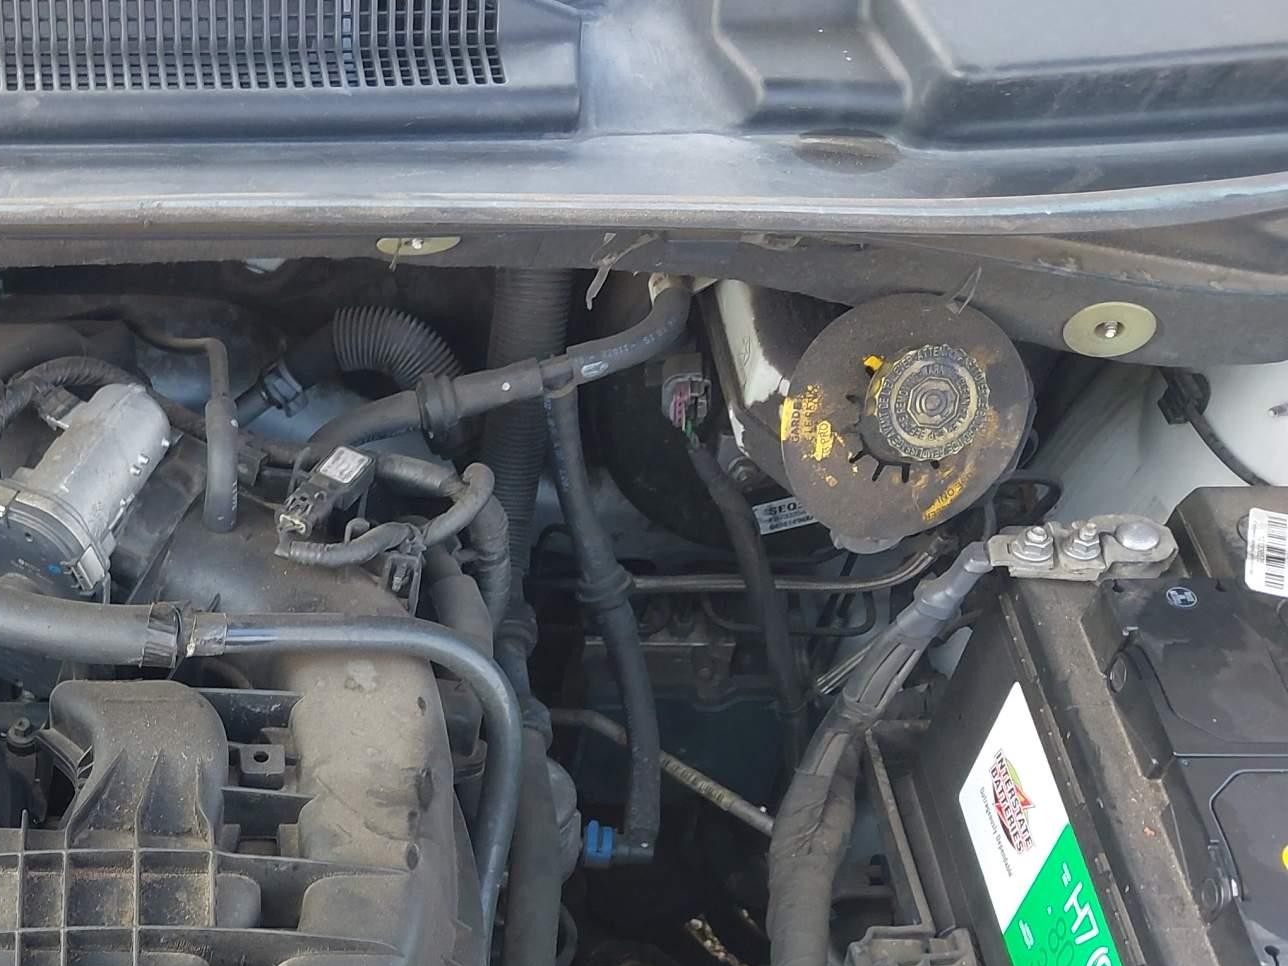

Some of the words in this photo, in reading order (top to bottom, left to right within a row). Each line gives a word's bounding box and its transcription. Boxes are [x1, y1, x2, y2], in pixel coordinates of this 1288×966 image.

[990, 766, 1024, 852] BATTERIES
[995, 751, 1033, 849] INTERSTATE
[1064, 881, 1100, 945] H7
